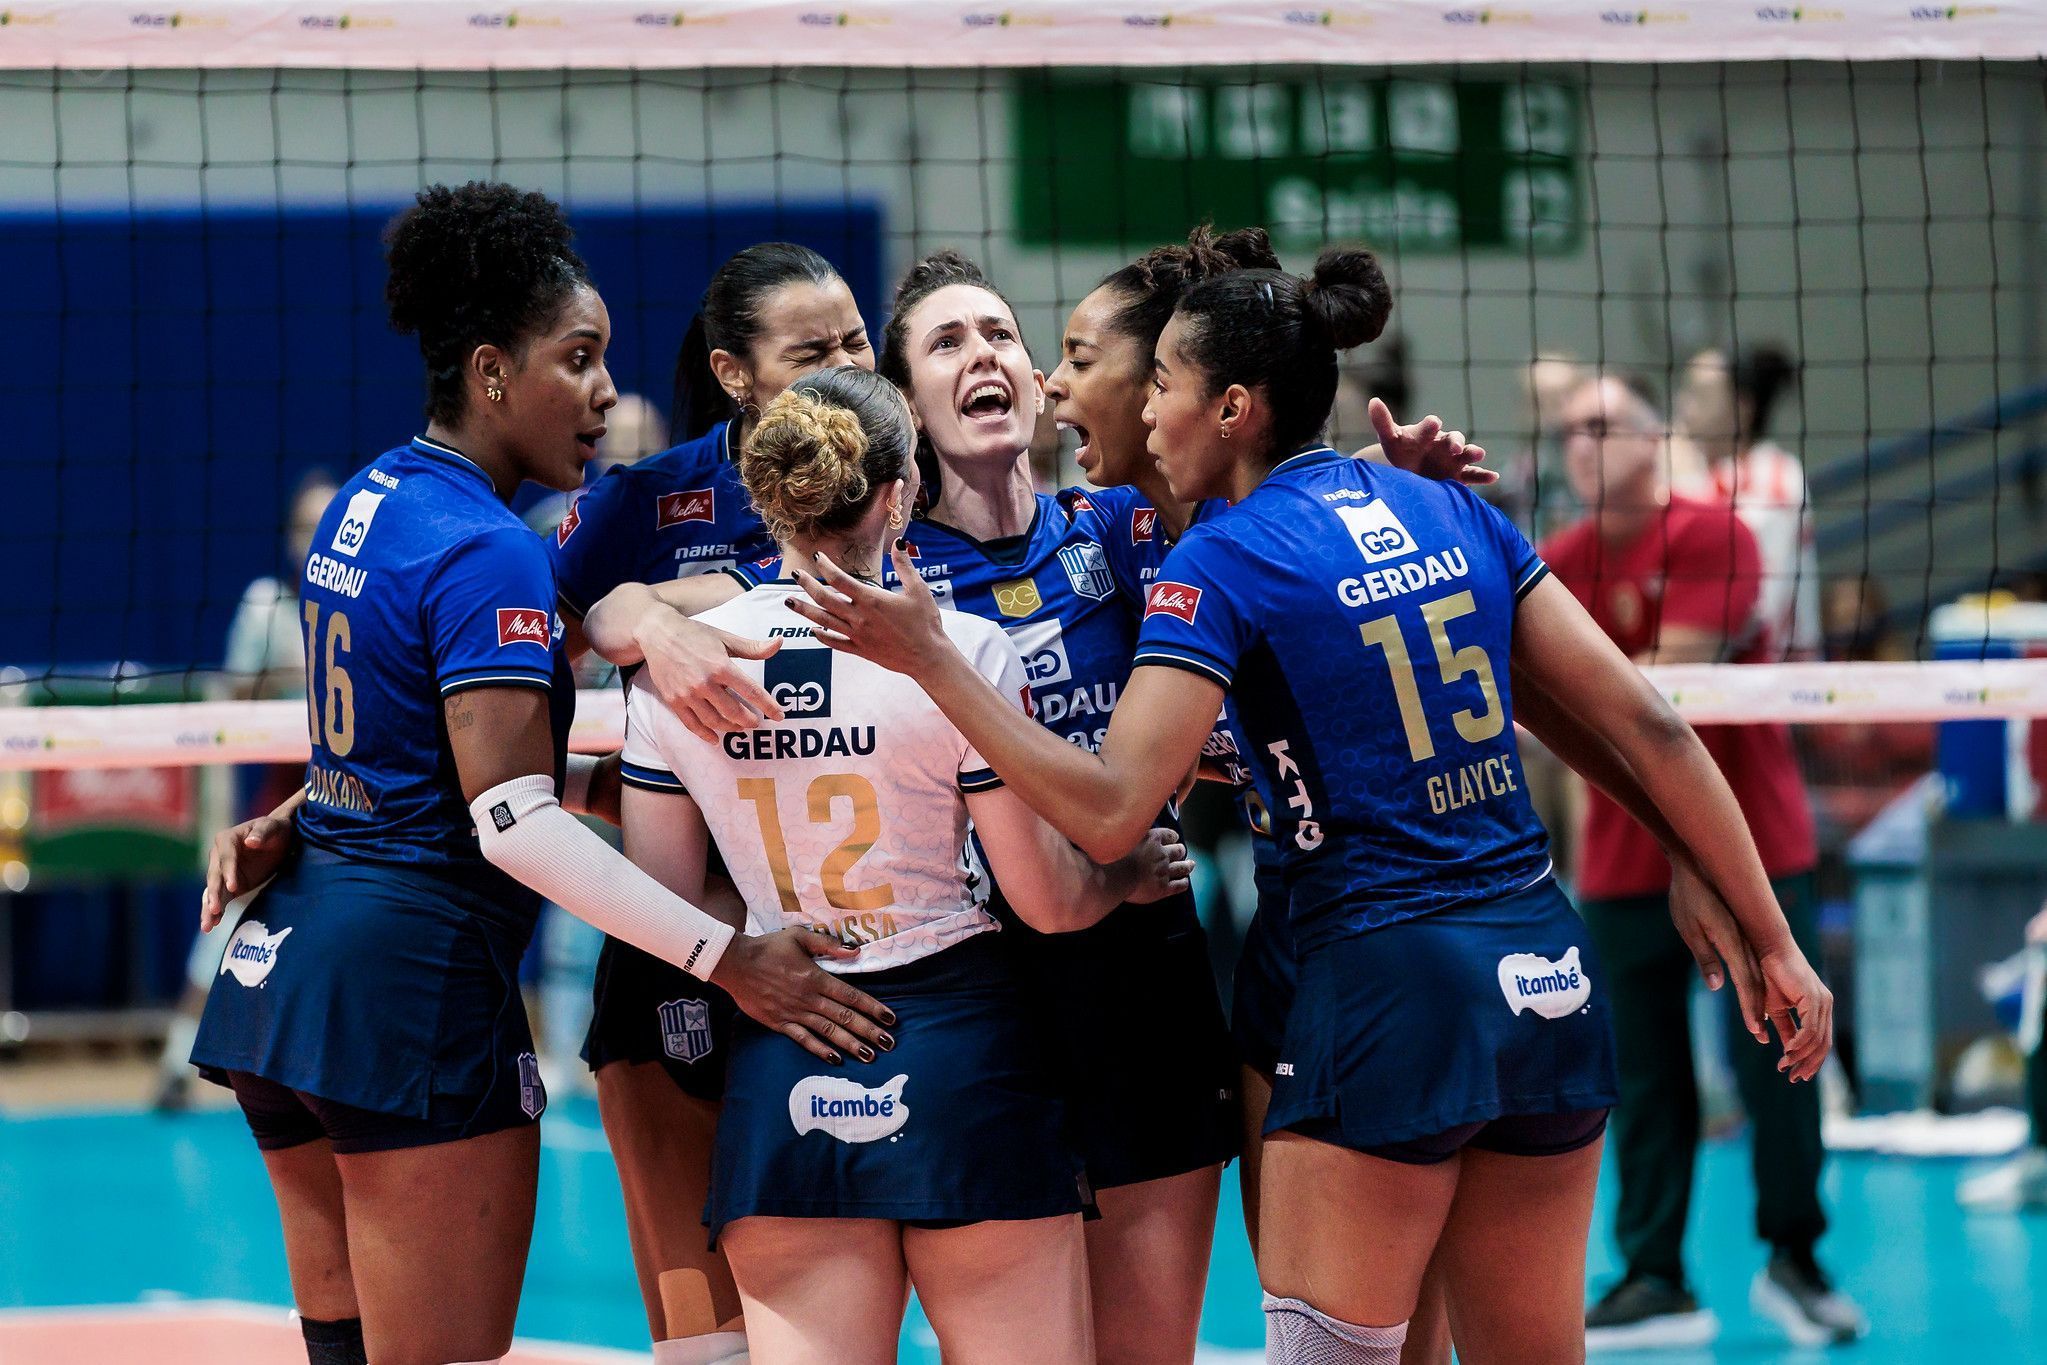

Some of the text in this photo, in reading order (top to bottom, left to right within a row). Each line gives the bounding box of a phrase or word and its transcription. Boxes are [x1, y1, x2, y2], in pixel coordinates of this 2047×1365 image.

[665, 497, 705, 518] Melitta
[306, 552, 368, 599] GERDAU
[886, 563, 953, 582] nkal
[1337, 546, 1469, 608] GERDAU
[1149, 586, 1188, 611] Melitta
[505, 613, 545, 638] Melitta
[305, 599, 355, 757] 16
[1359, 589, 1505, 763] 15
[723, 725, 876, 761] GERDAU
[1267, 739, 1325, 851] KTO
[1426, 753, 1518, 815] GLAYCE
[736, 773, 896, 913] 12
[231, 938, 276, 964] itambé
[1515, 966, 1581, 997] itambé
[811, 1094, 894, 1118] itambé
